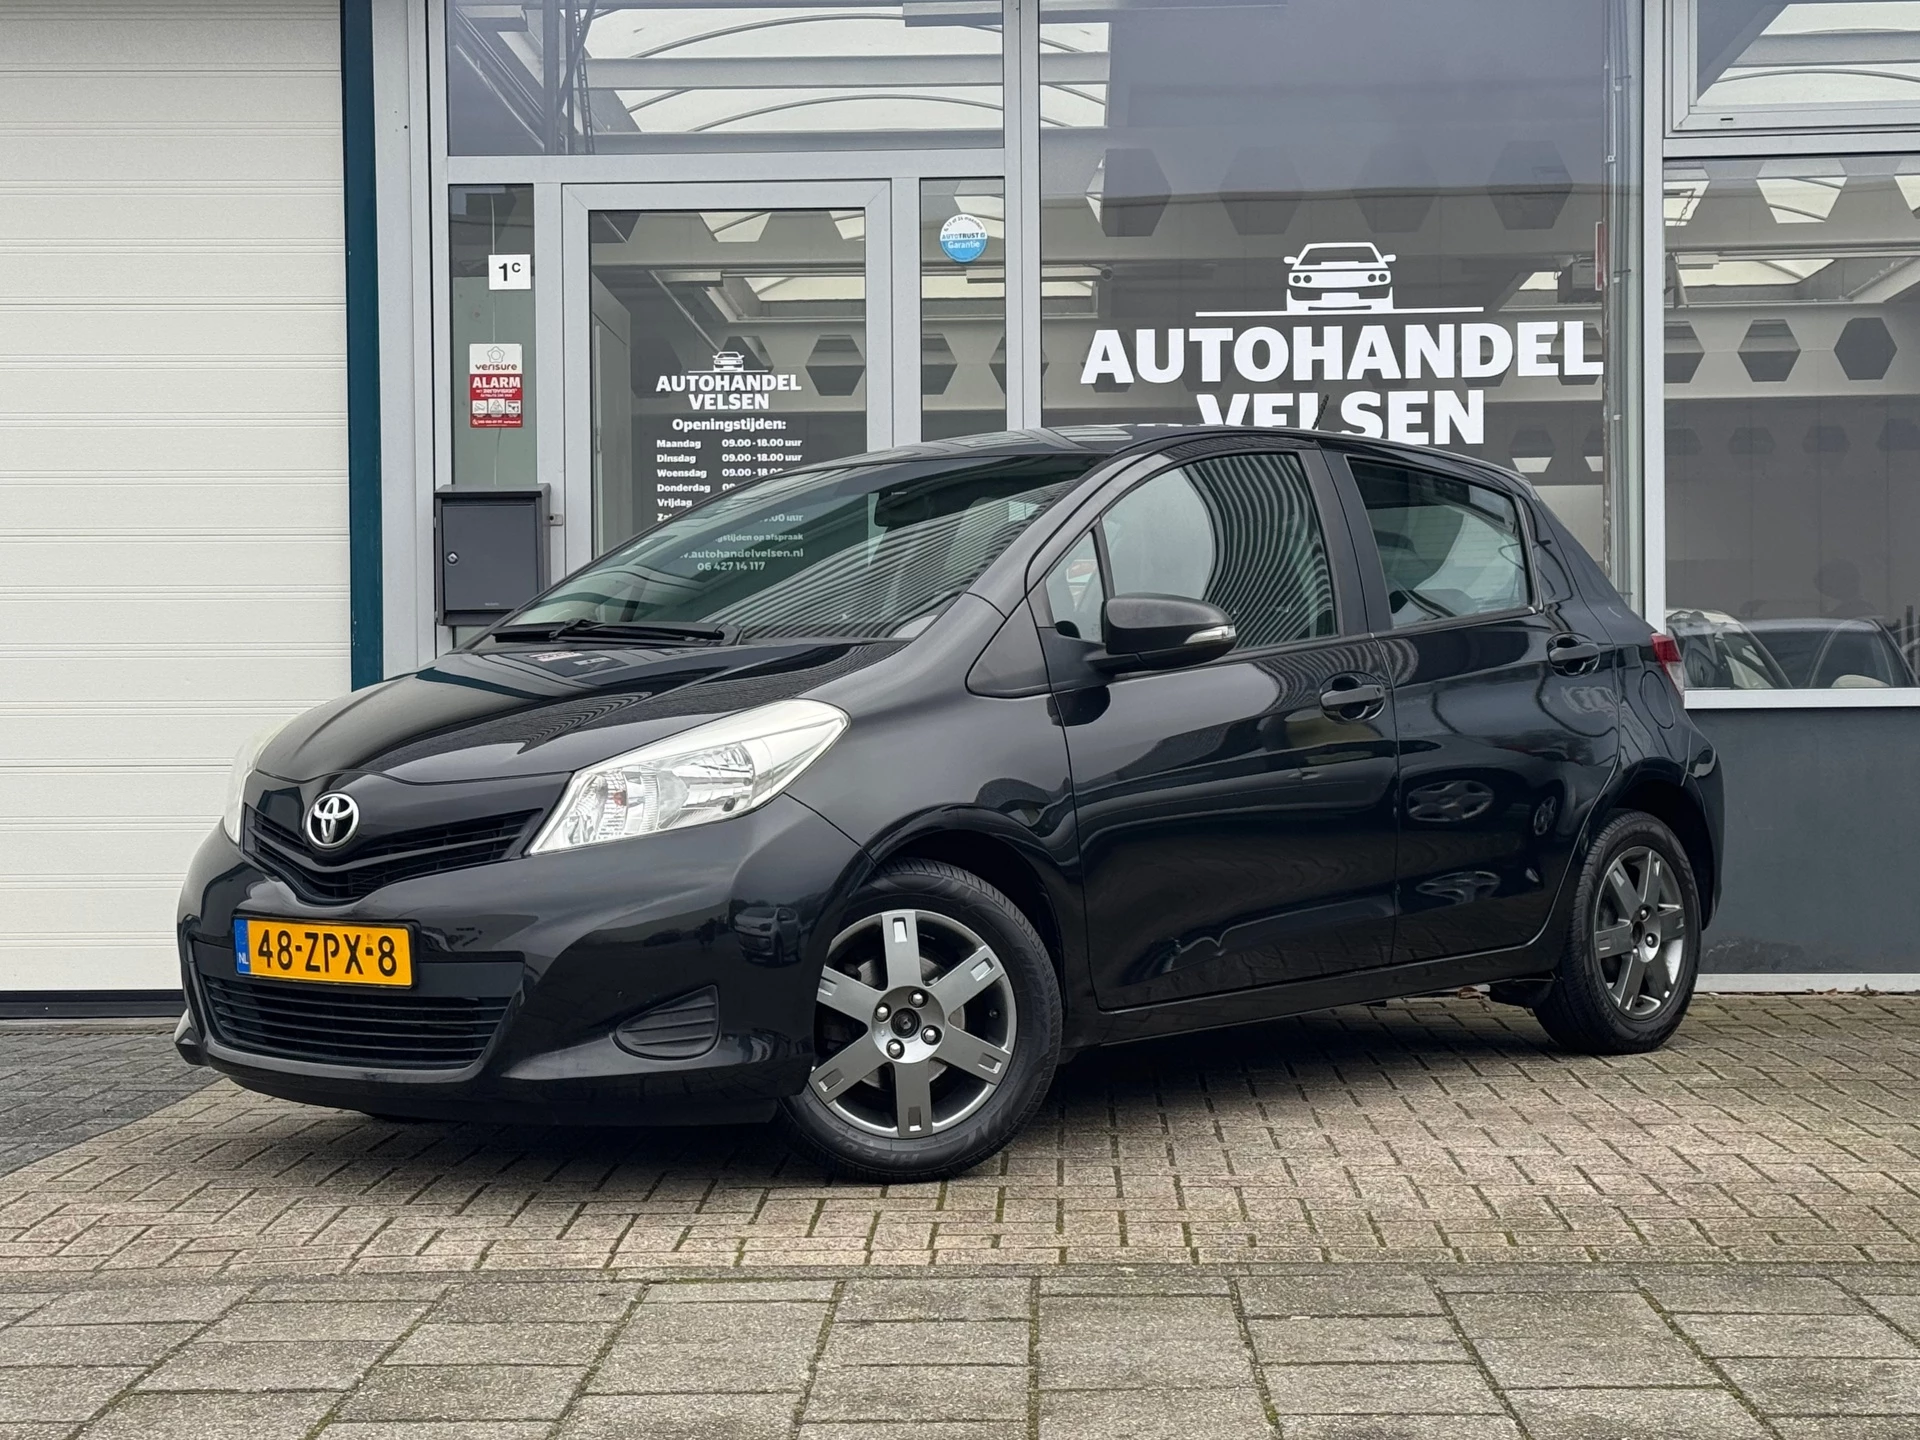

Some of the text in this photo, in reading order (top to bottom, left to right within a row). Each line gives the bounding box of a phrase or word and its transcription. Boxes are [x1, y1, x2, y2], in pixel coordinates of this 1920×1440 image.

[942, 232, 980, 240] AUTOTRUST
[947, 240, 981, 249] Garantie
[1080, 320, 1604, 385] AUTOHANDEL
[475, 363, 517, 371] verisure
[472, 376, 521, 388] ALARM
[656, 374, 802, 392] AUTOHANDEL
[688, 393, 770, 410] VELSEN
[672, 418, 787, 432] Openingstijden:
[656, 439, 702, 449] Maandag
[721, 438, 752, 447] 09.00
[757, 438, 784, 447] 18.00
[784, 439, 803, 447] uur
[656, 454, 697, 464] Dinsdag
[721, 453, 752, 462] 09.00
[757, 453, 784, 462] 18.00
[784, 454, 803, 462] uur
[656, 468, 708, 479] Woensdag
[721, 468, 752, 477] 09.00
[656, 483, 711, 493] Donderdag
[656, 498, 693, 508] Vrijdag
[786, 514, 804, 522] uur
[753, 534, 765, 543] op
[765, 533, 804, 543] afspraak
[697, 561, 766, 571] 06 427 14 117
[238, 951, 249, 965] NL
[258, 928, 398, 977] 48-ZPX-8
